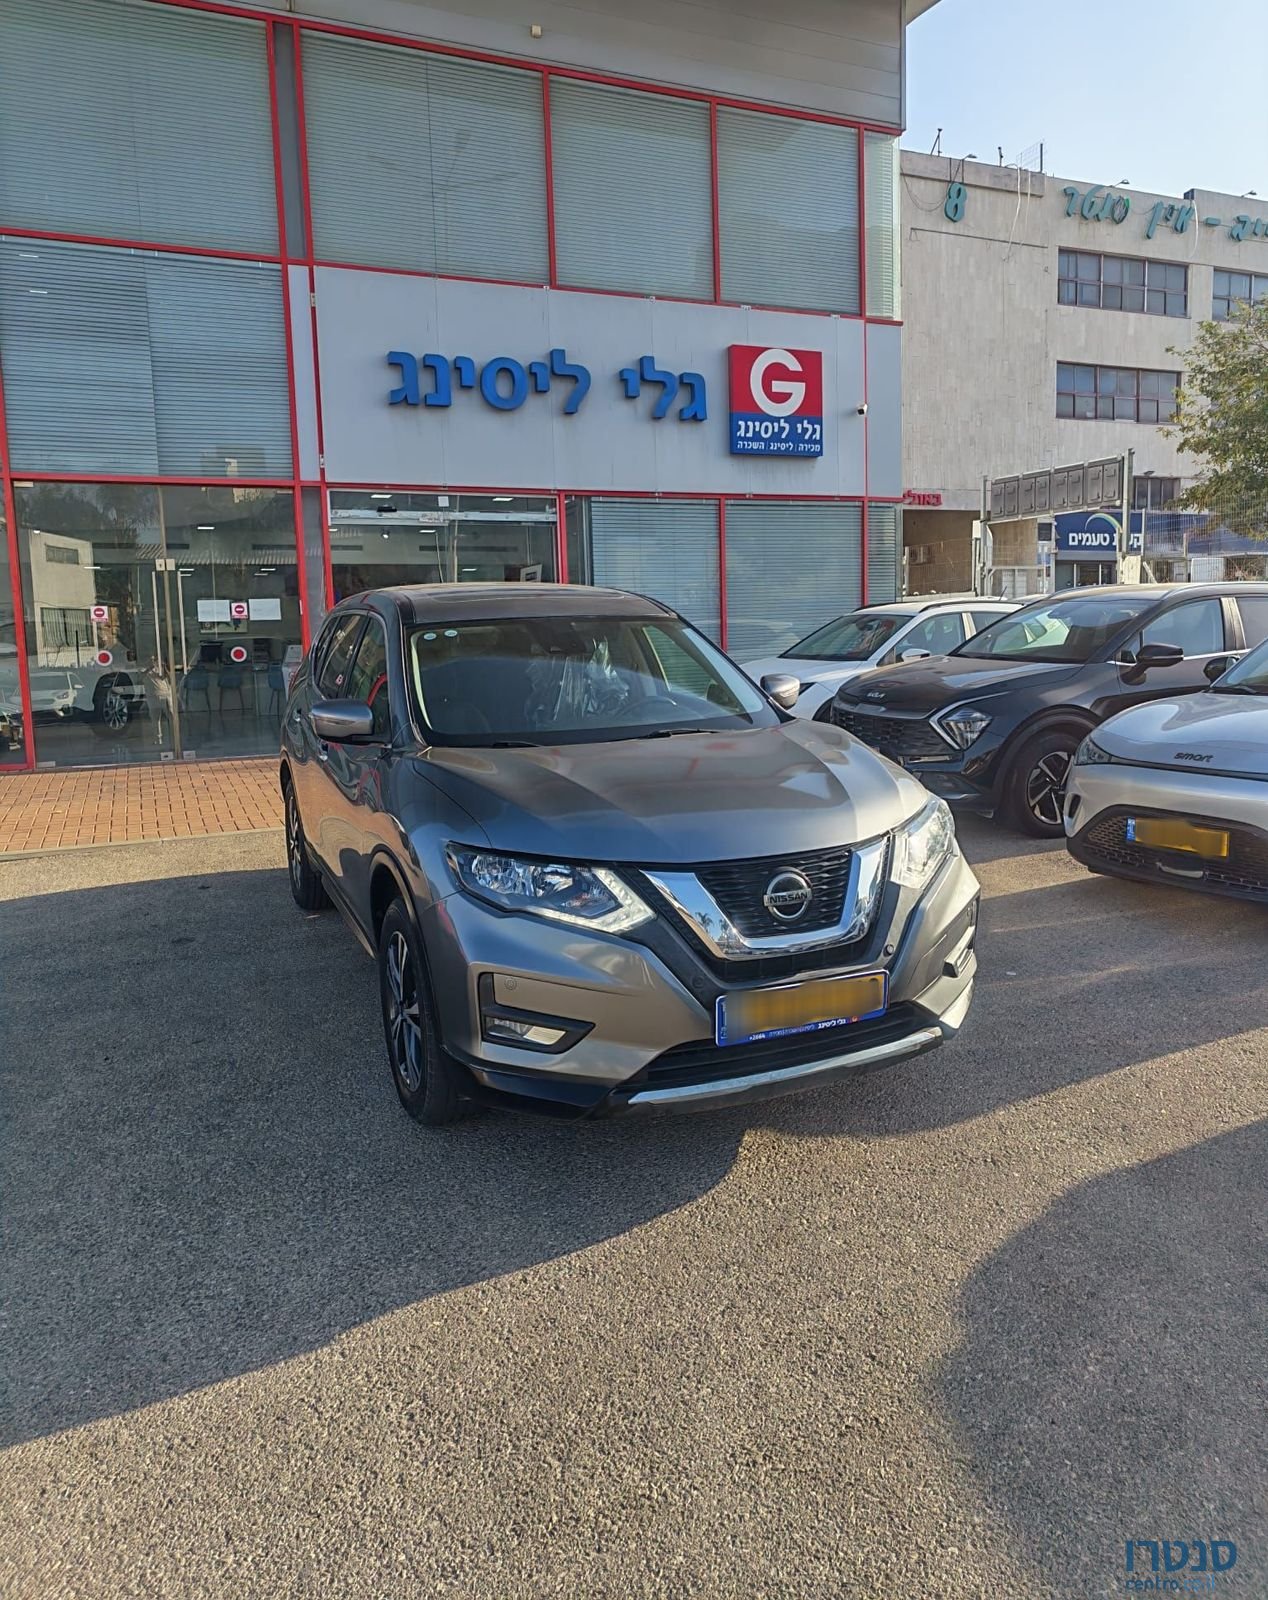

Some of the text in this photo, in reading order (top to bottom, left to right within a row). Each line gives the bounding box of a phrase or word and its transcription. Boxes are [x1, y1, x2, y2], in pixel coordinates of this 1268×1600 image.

[944, 182, 967, 223] 8
[387, 349, 708, 421] גלי ליסינג
[750, 348, 806, 417] G
[736, 418, 821, 440] גלי ליסינג
[737, 440, 821, 452] מכירה ליסינג השכרה
[1068, 532, 1110, 546] טעמים
[1174, 752, 1214, 763] smart
[770, 891, 808, 904] NISSAN
